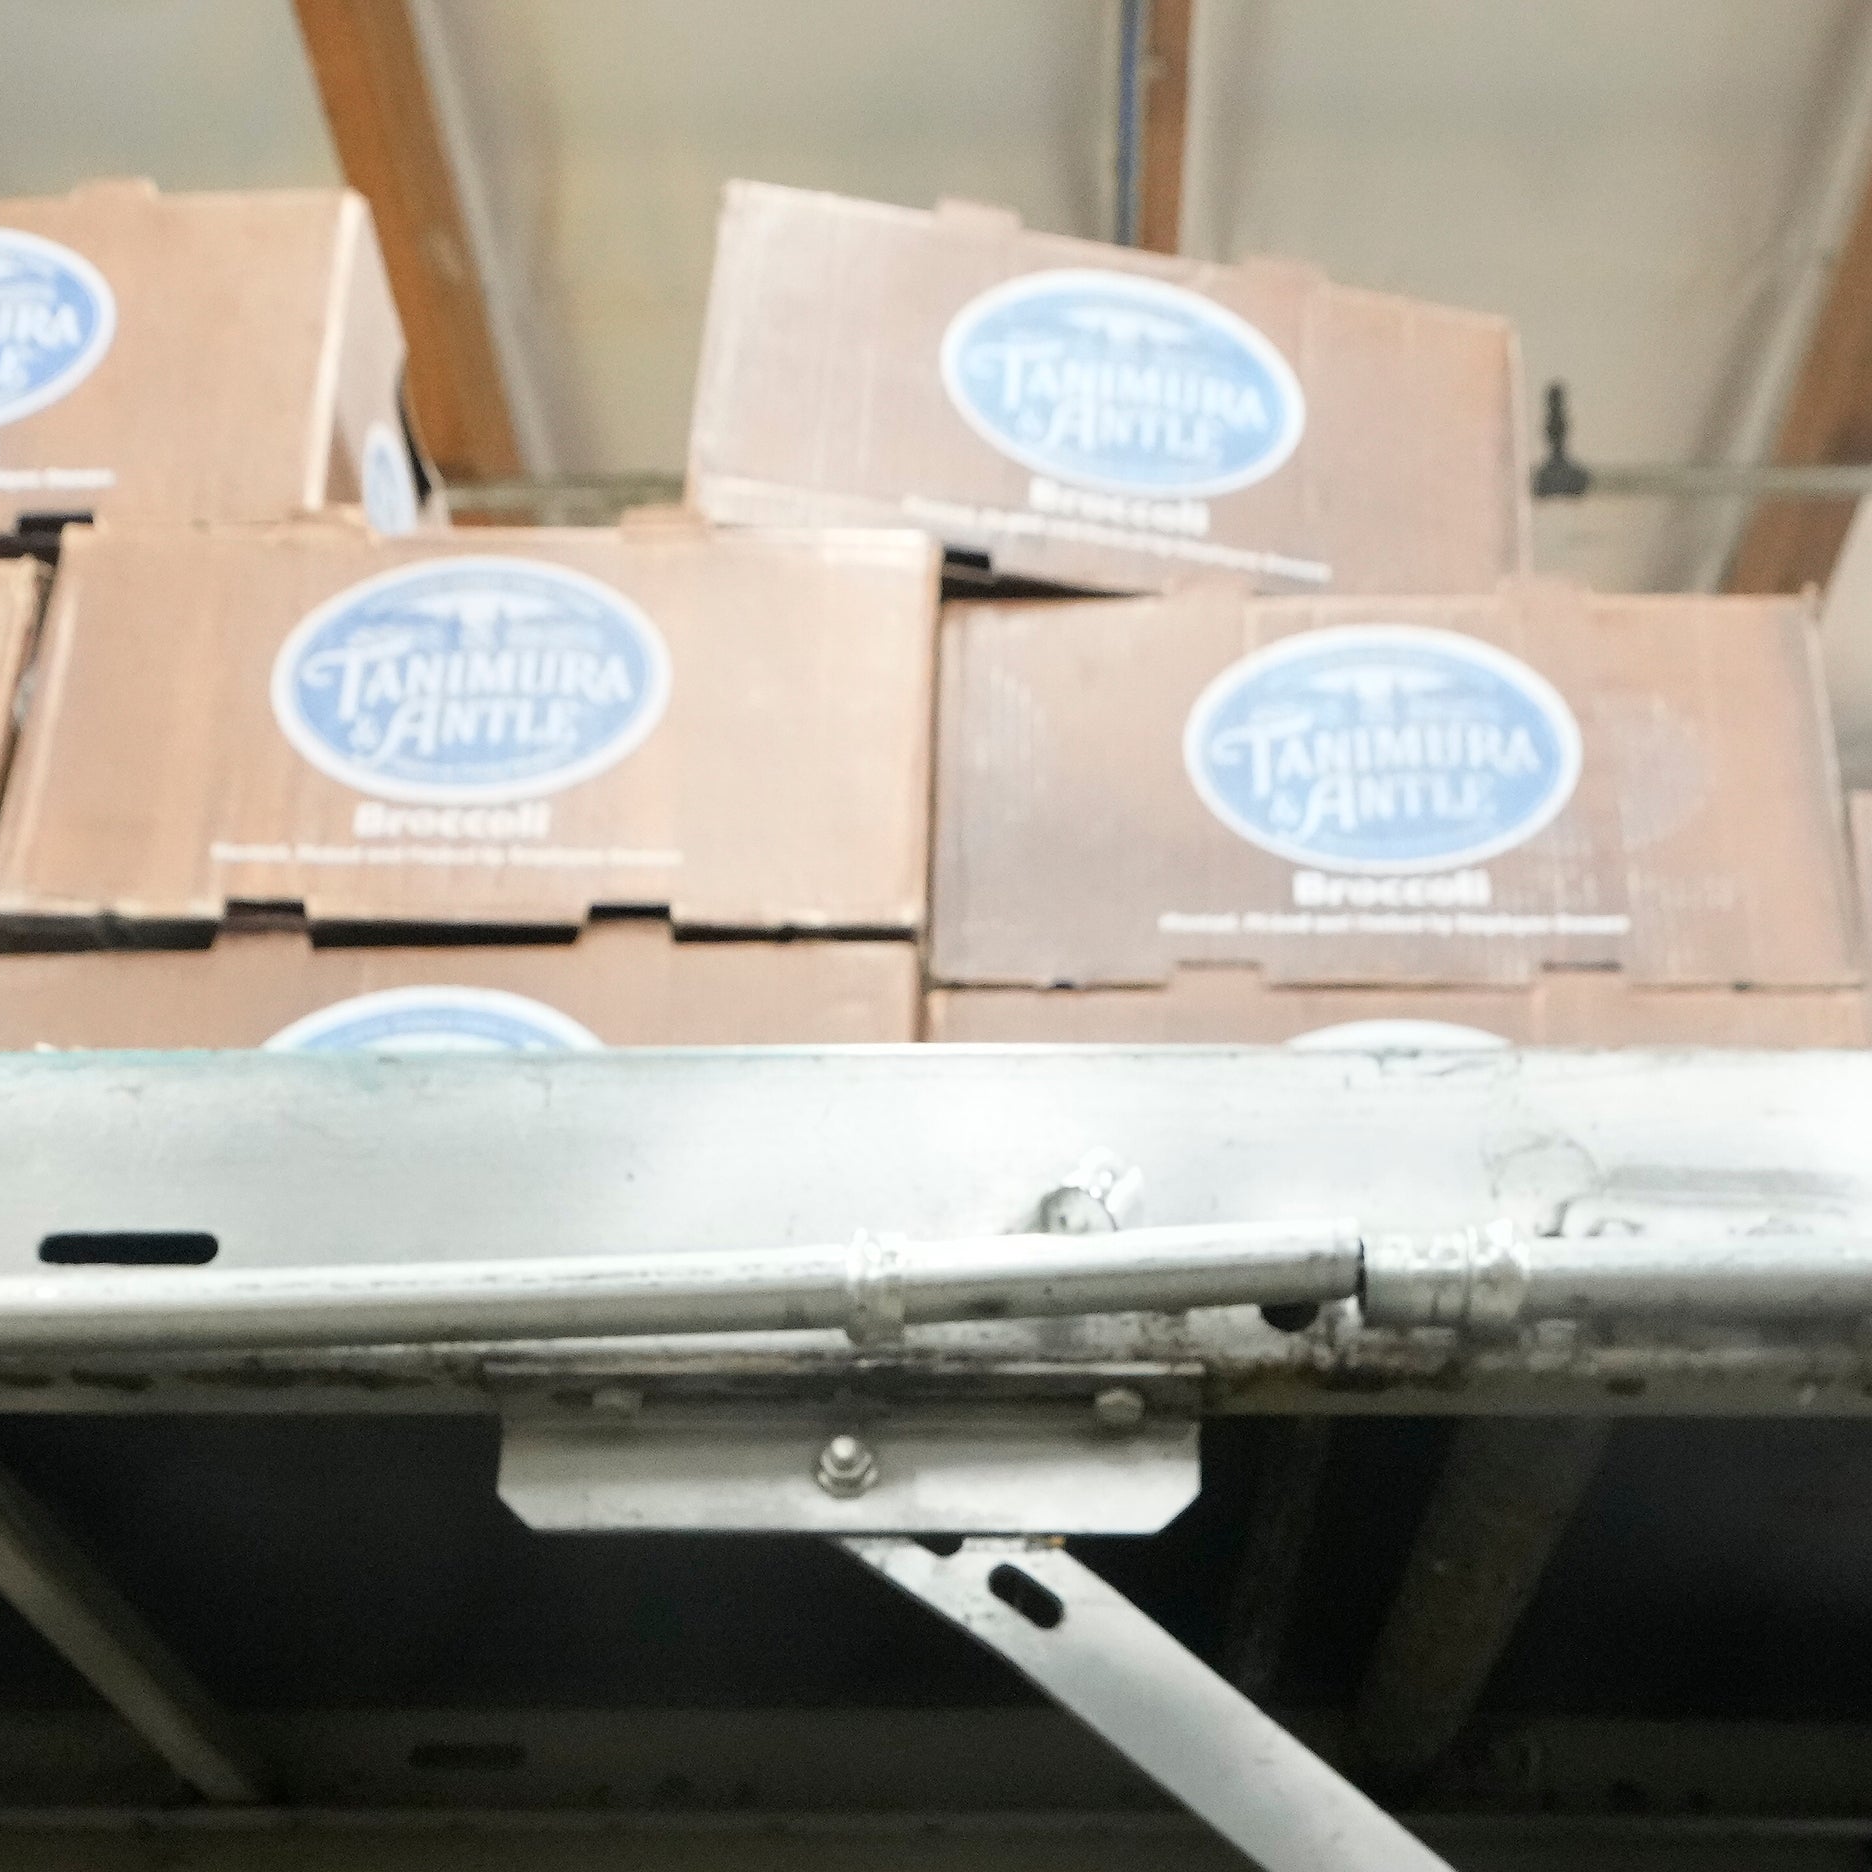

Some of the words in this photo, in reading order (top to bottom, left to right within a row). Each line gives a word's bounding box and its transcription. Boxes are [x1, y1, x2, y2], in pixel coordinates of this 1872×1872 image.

[965, 340, 1270, 433] TANIMURA
[1038, 396, 1218, 460] ANTLE
[1028, 475, 1211, 538] Broccoli
[300, 631, 633, 723] TANIMURA
[360, 692, 582, 770] ANTLE
[1211, 711, 1543, 799] TANIMURA
[352, 802, 551, 840] Broccoli
[1285, 770, 1499, 845] ANTLE
[1291, 869, 1492, 908] Broccoli
